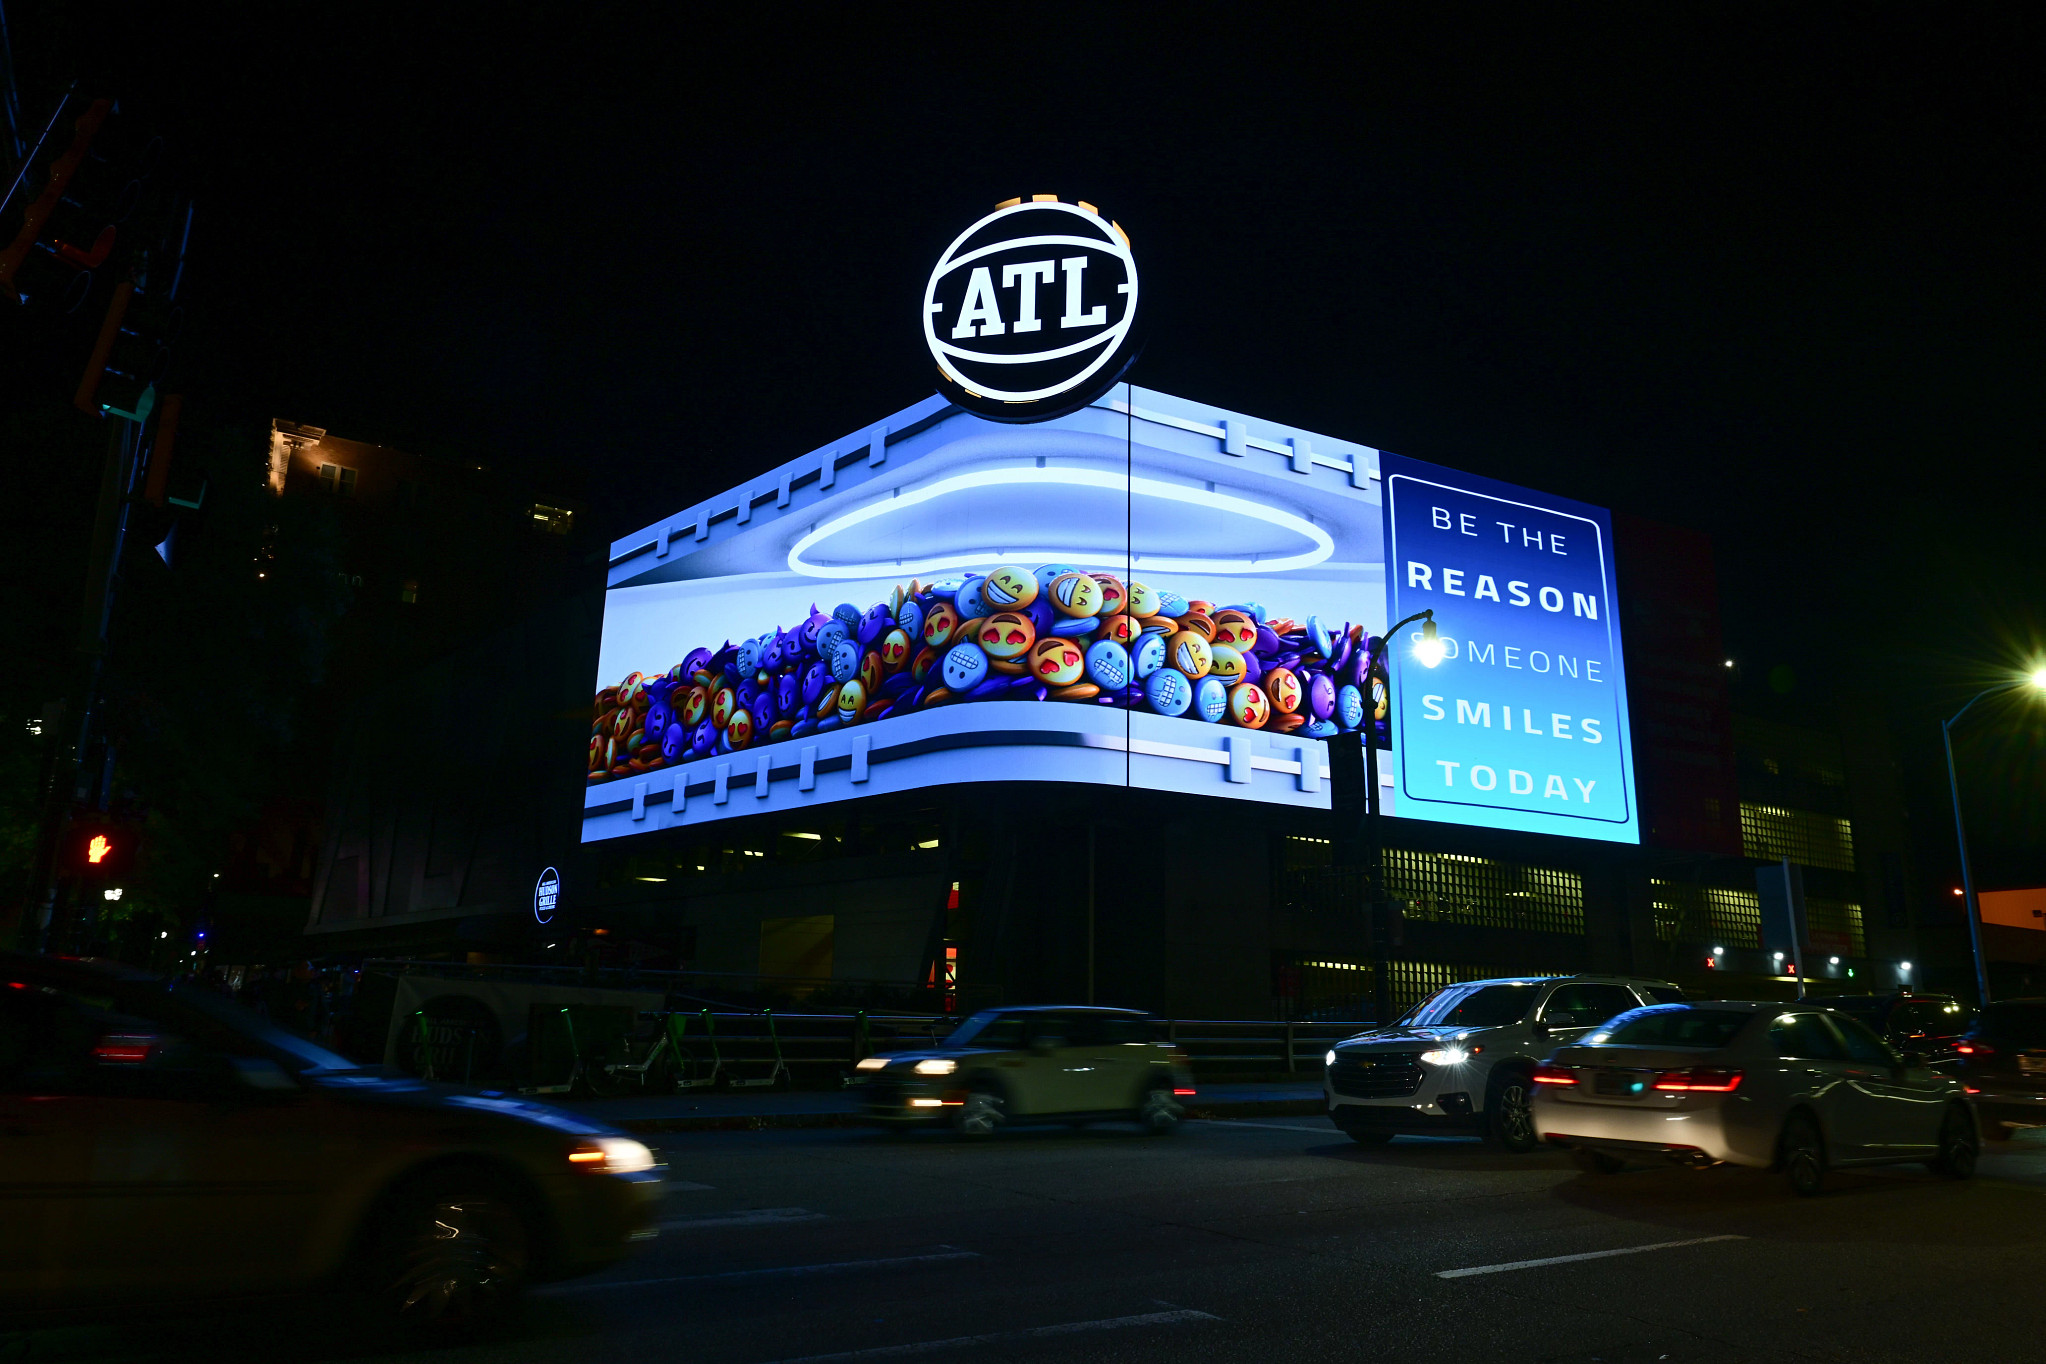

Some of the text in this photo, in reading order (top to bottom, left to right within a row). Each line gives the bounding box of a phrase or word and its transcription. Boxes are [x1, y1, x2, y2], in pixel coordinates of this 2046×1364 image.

[952, 256, 1107, 339] ATL
[1431, 506, 1568, 556] BE THE
[1407, 560, 1599, 621] REASON
[1422, 694, 1603, 745] SMILES
[1436, 760, 1597, 804] TODAY
